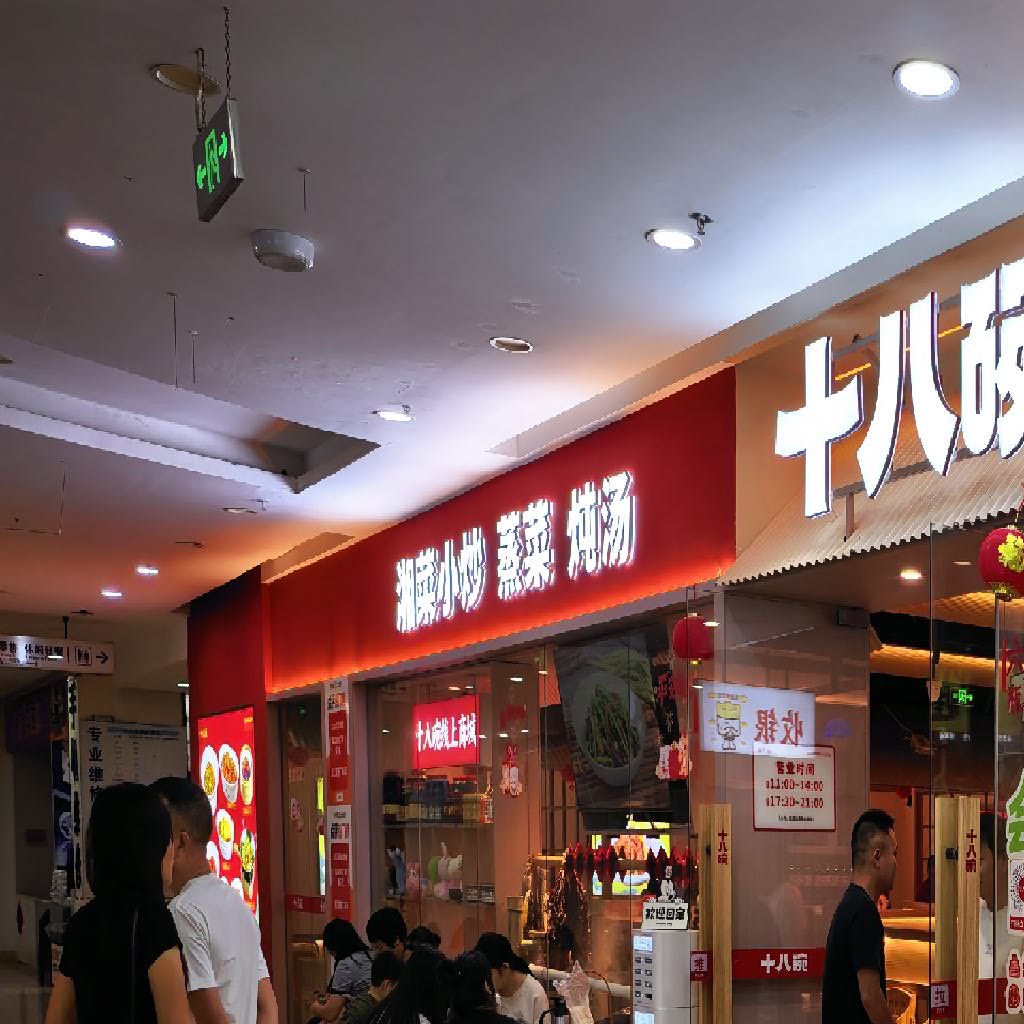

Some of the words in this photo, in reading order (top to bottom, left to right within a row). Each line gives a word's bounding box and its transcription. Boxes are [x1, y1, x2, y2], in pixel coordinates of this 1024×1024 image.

[396, 527, 486, 634] 湘菜小炒
[498, 499, 555, 600] 蒸菜
[567, 471, 637, 580] 炖汤
[89, 726, 104, 800] 专业维
[776, 761, 815, 776] 营业时间
[717, 829, 728, 865] 十八碗
[645, 907, 685, 920] 欢迎回家
[694, 957, 704, 971] 推
[761, 953, 808, 973] 十八碗
